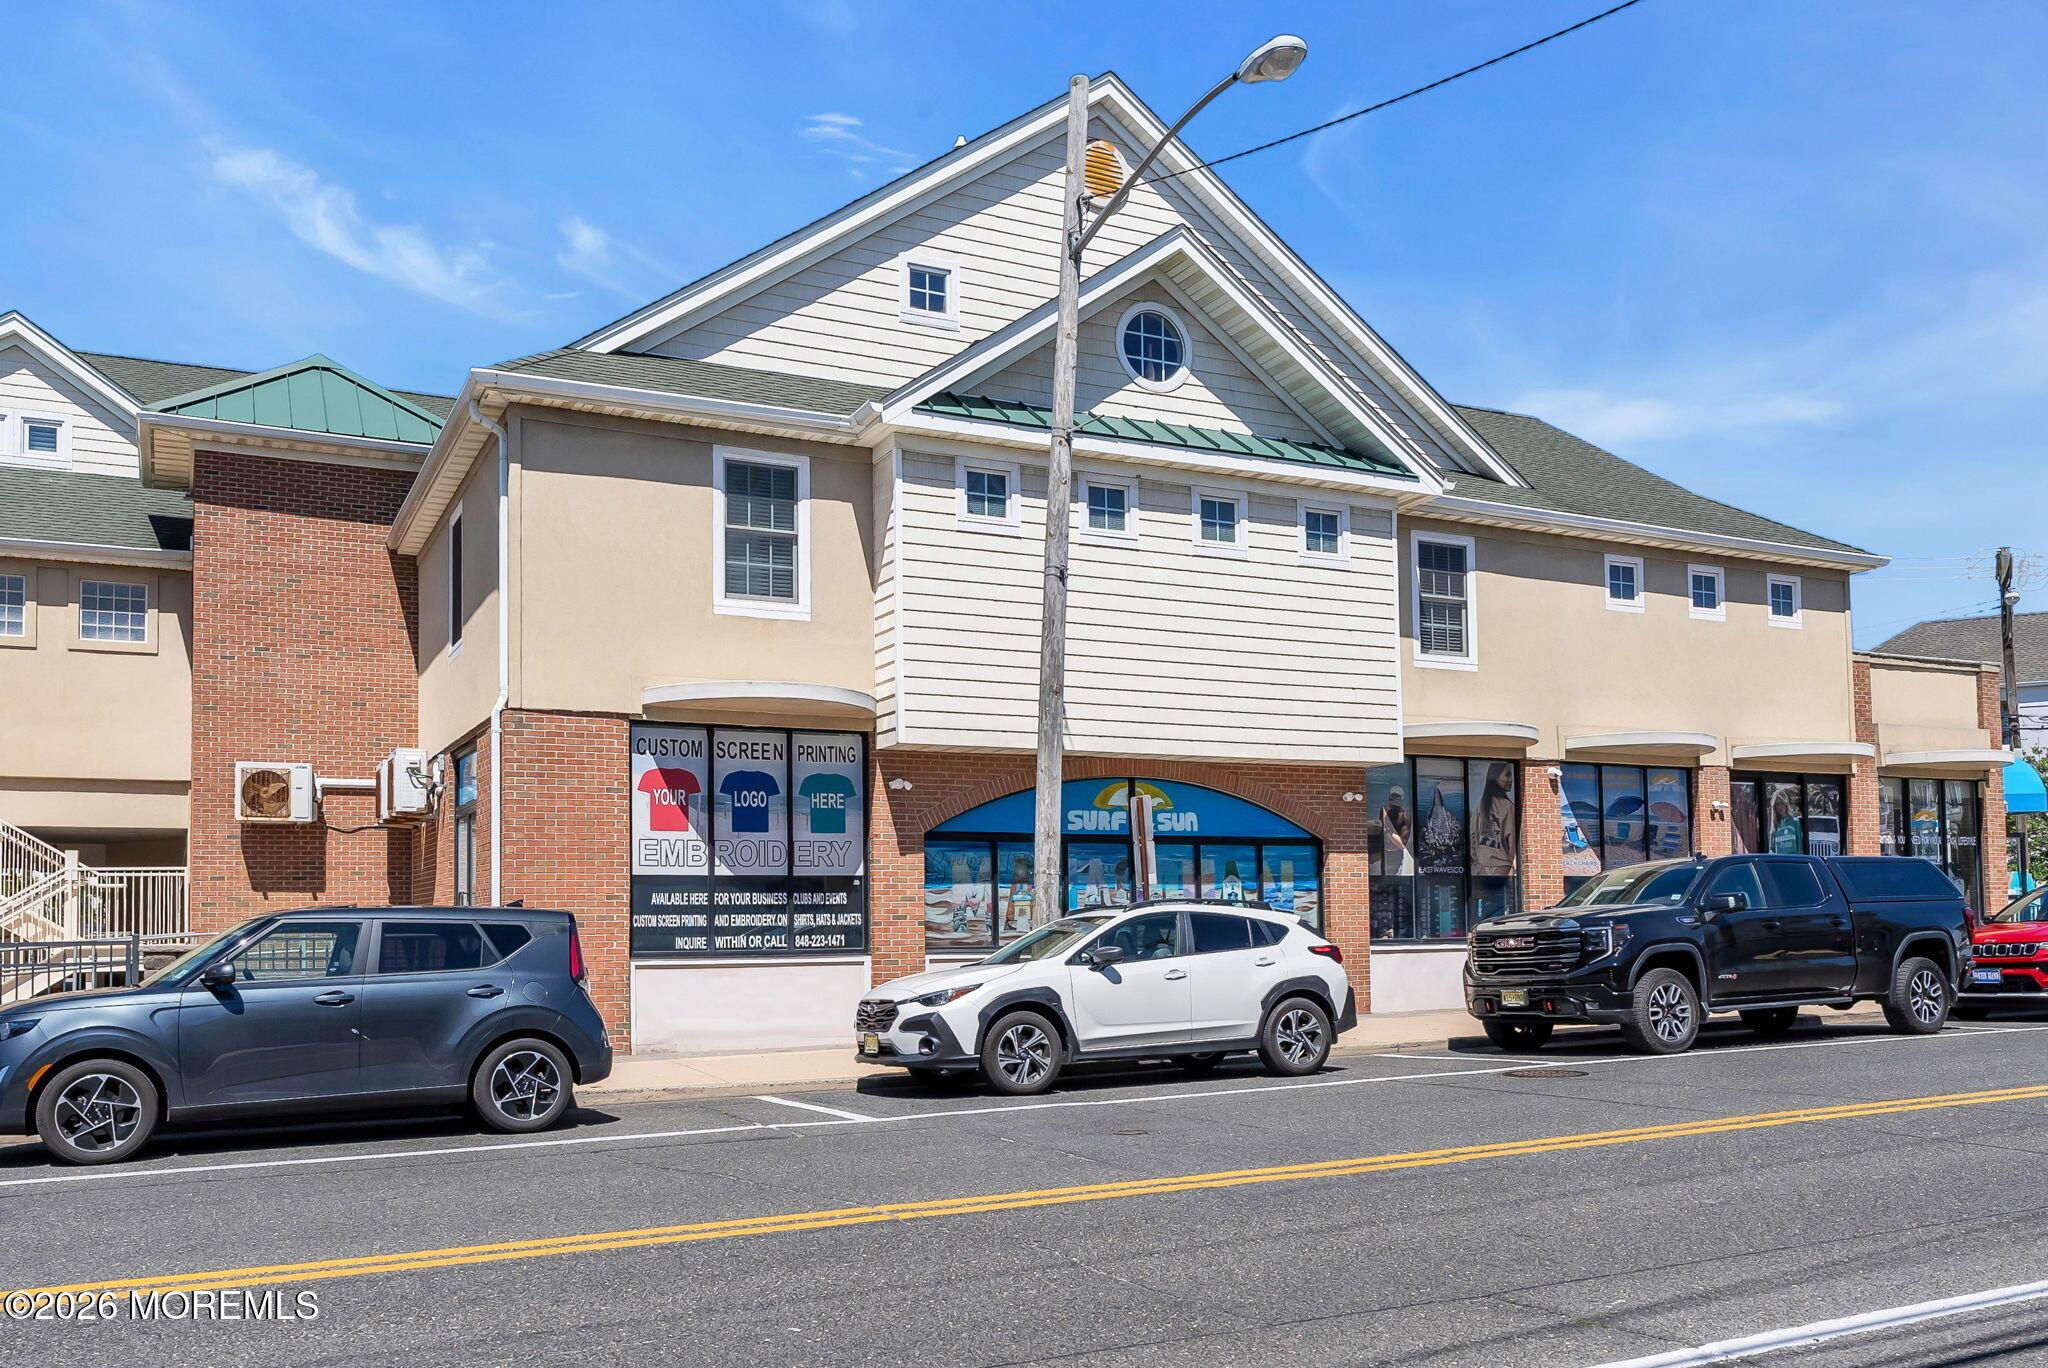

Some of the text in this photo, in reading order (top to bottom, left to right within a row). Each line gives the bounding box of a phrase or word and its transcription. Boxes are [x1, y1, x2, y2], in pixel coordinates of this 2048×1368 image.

[636, 738, 857, 763] CUSTOM SCREEN PRINTING
[653, 788, 845, 809] YOUR LOGO HERE
[1067, 810, 1127, 831] SURF
[651, 892, 848, 906] AVAILABLE HERE FOR YOUR BUSINESS CLUBS AND EVENTS
[632, 913, 862, 927] CUSTOM SCREEN PRINTING AND EMBROIDERY ON SHIRTS, HATS & JACKETS
[675, 934, 845, 949] INQUIRE WITHIN OR CALL 848-223-1471
[1495, 936, 1535, 949] GMC
